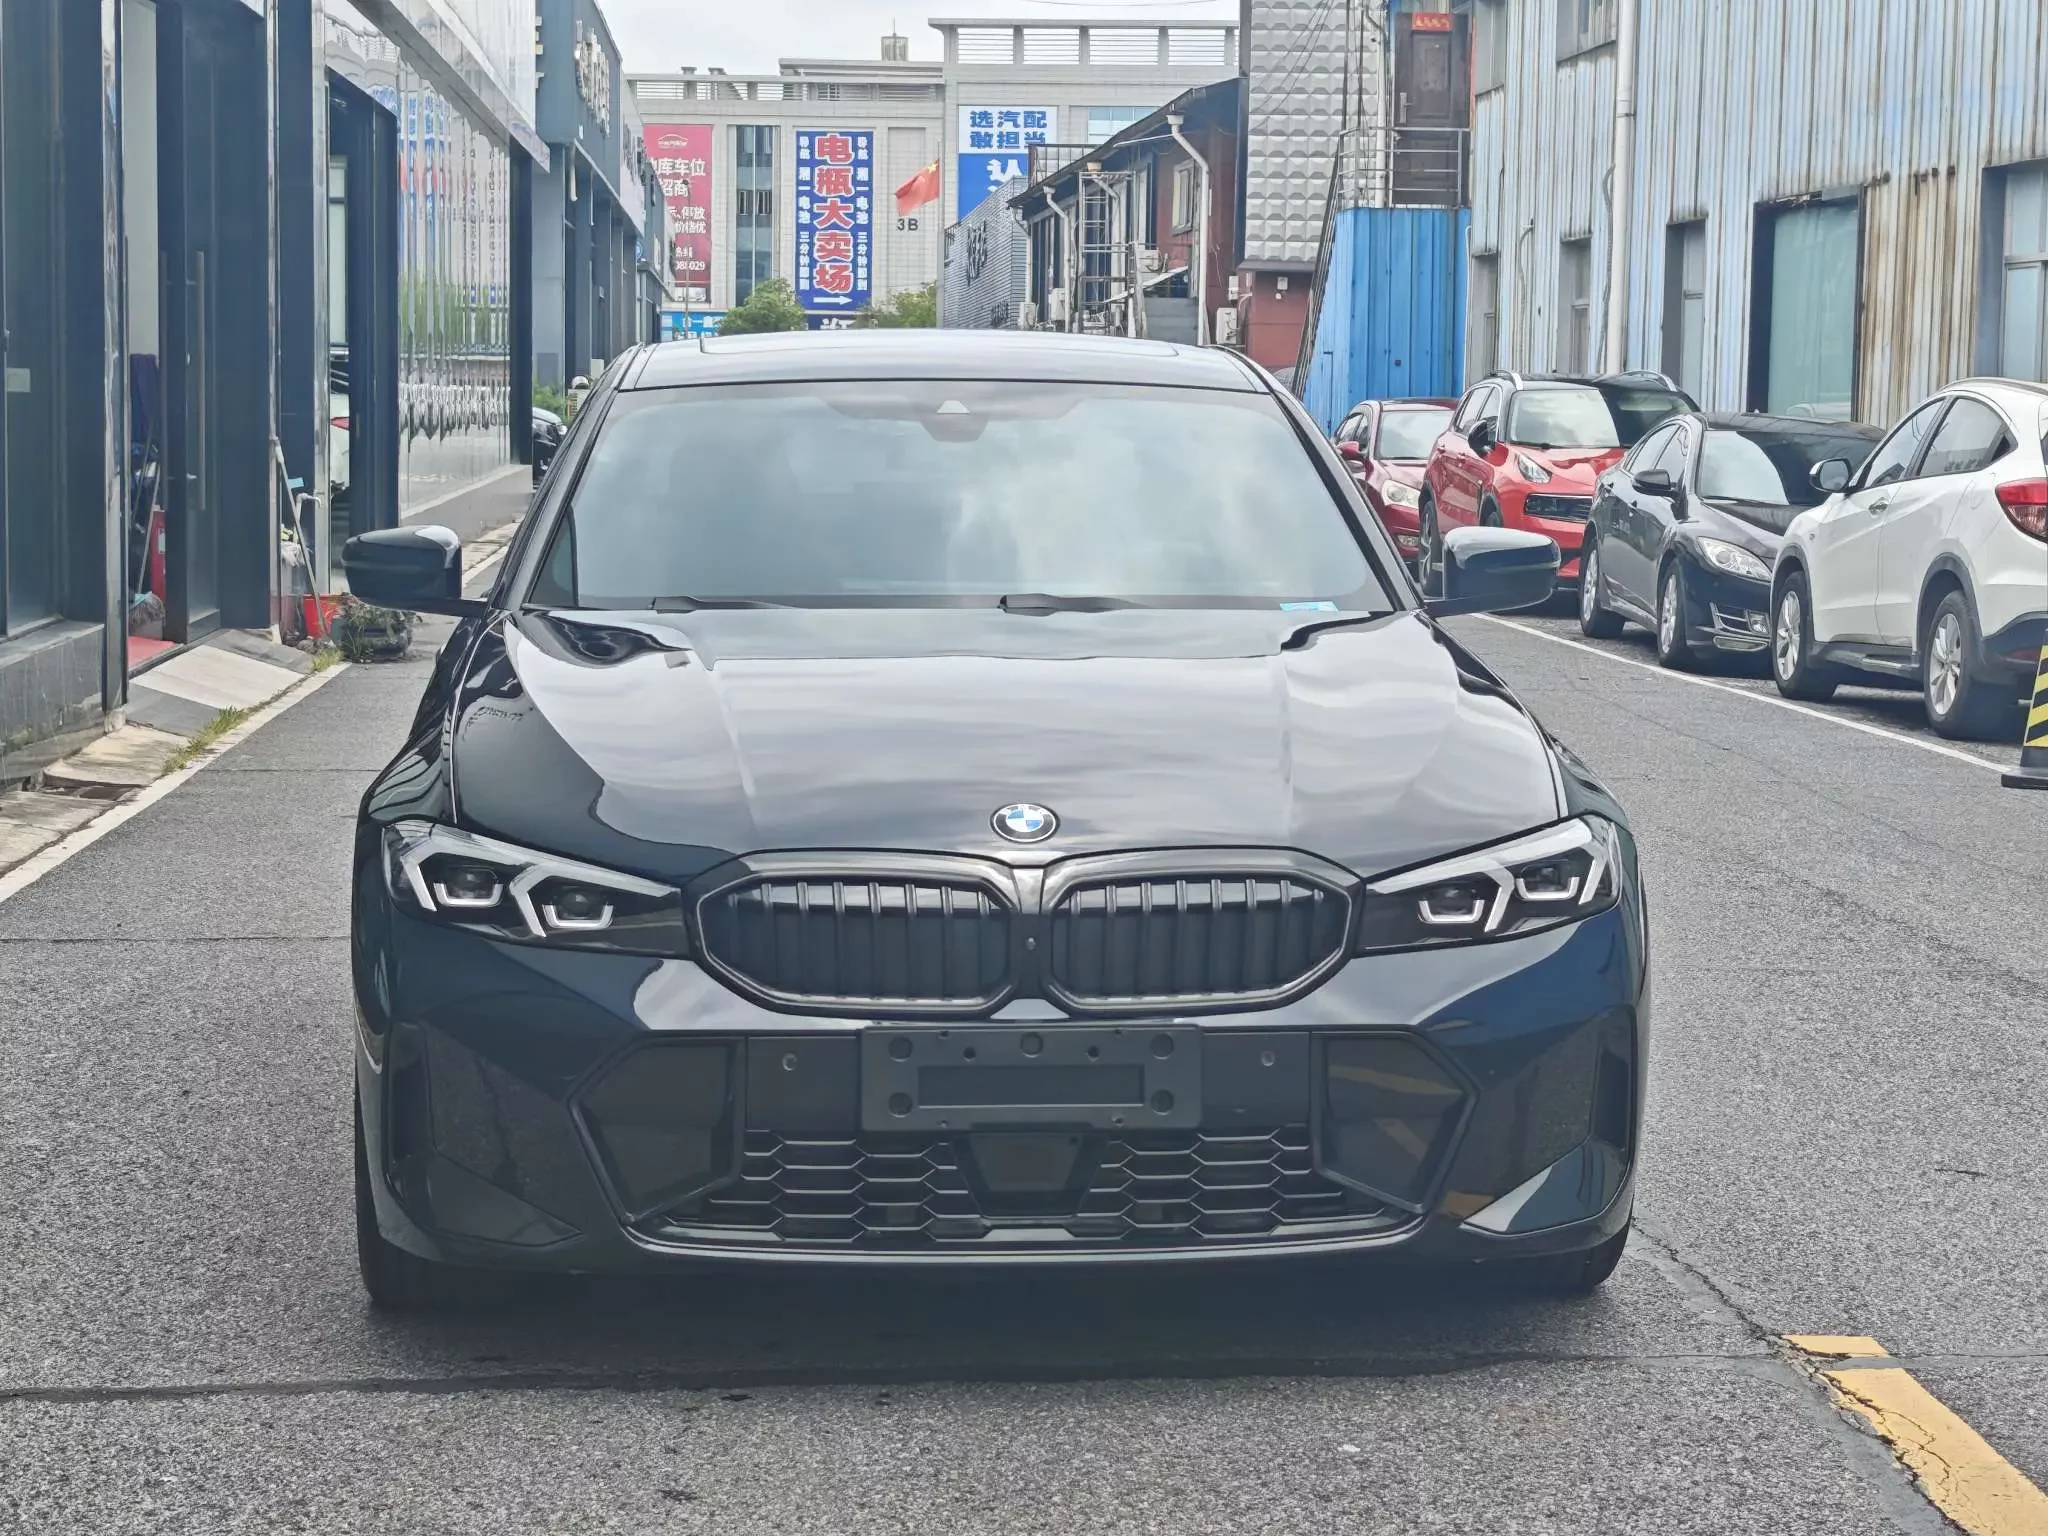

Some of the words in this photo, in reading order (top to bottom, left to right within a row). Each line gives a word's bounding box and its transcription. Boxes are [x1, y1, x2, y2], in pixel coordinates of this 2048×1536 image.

[969, 110, 1047, 129] 选汽配
[969, 131, 1046, 149] 敢担当
[813, 133, 855, 293] 电瓶大卖场
[896, 218, 919, 231] 3B
